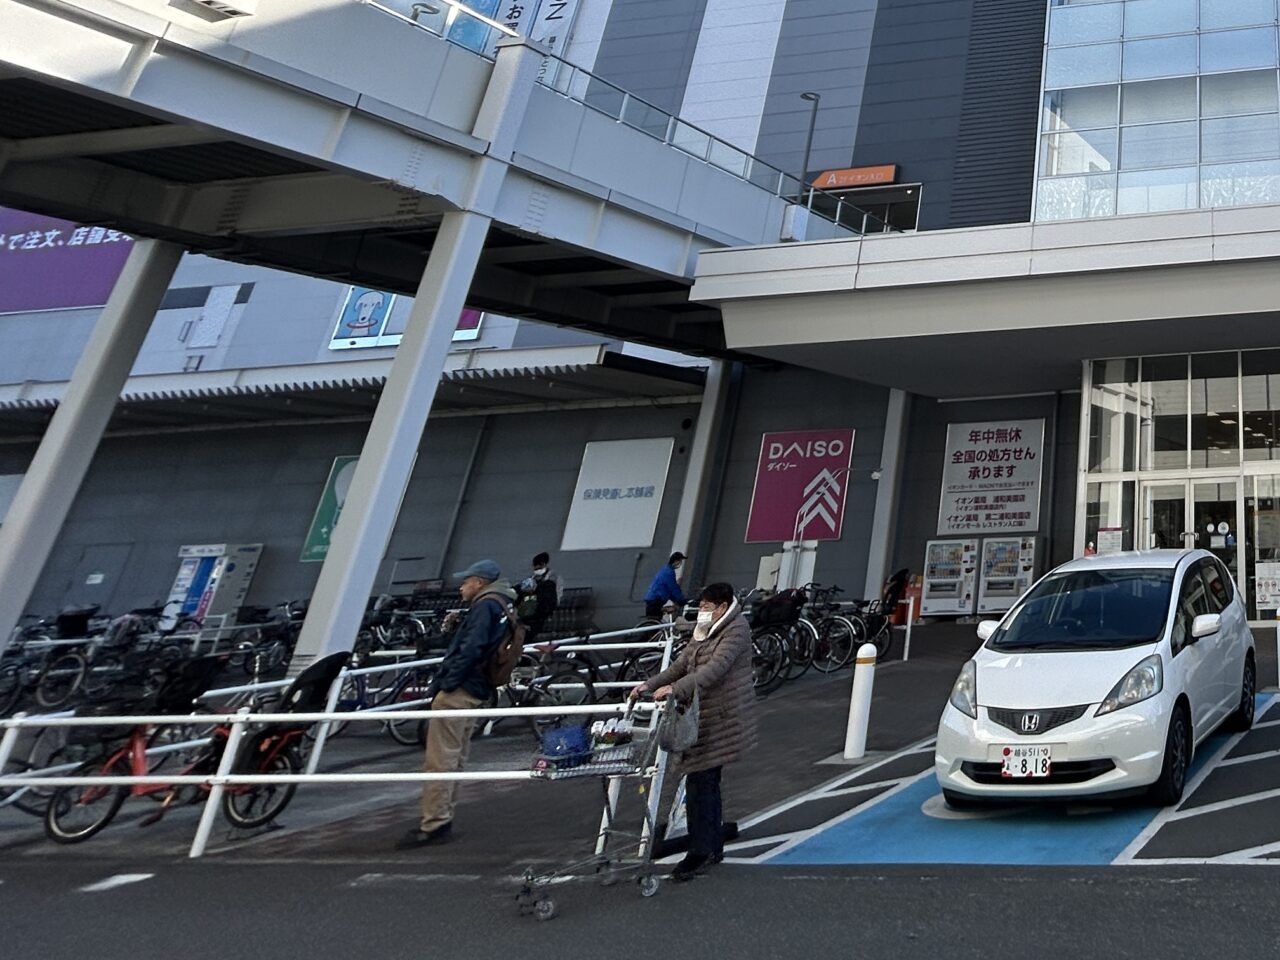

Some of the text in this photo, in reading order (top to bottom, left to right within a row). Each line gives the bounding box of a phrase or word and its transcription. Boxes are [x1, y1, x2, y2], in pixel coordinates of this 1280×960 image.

[827, 173, 837, 185] A
[968, 427, 1022, 444] 年中無休
[768, 440, 844, 460] DAISO
[951, 447, 1036, 465] 全国の処方せん
[767, 462, 797, 471] ダイソー
[968, 465, 1017, 480] 承ります
